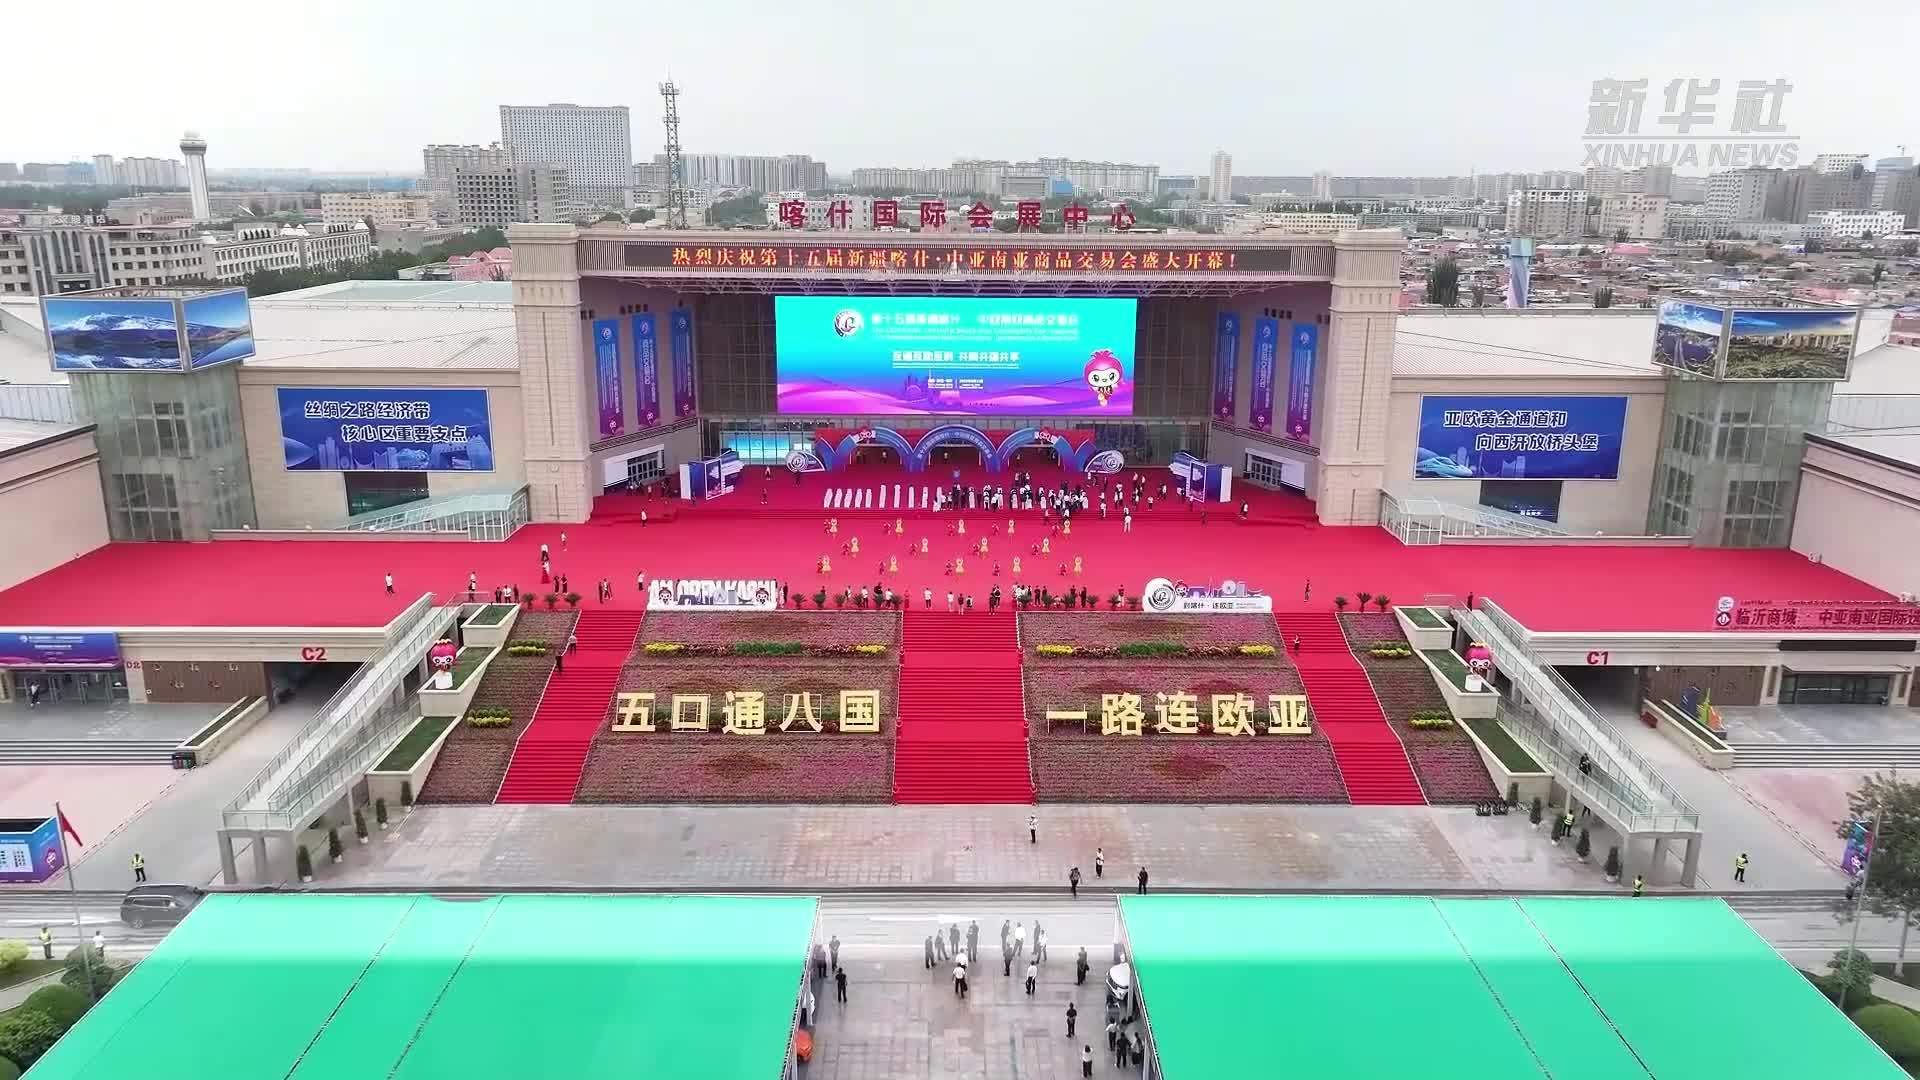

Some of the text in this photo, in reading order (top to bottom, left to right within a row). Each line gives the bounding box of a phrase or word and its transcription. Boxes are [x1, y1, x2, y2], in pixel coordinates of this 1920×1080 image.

[779, 199, 1136, 231] 喀什国际会展中心
[304, 400, 431, 419] 丝绸之路经济带
[1443, 409, 1568, 428] 亚欧黄金通道和
[342, 424, 468, 442] 核心区重要支点
[1475, 433, 1599, 451] 向西开放桥头堡
[302, 647, 328, 661] C2
[1586, 651, 1609, 665] C1
[611, 690, 880, 735] 五口通八国
[1046, 690, 1312, 736] 一路连欧亚
